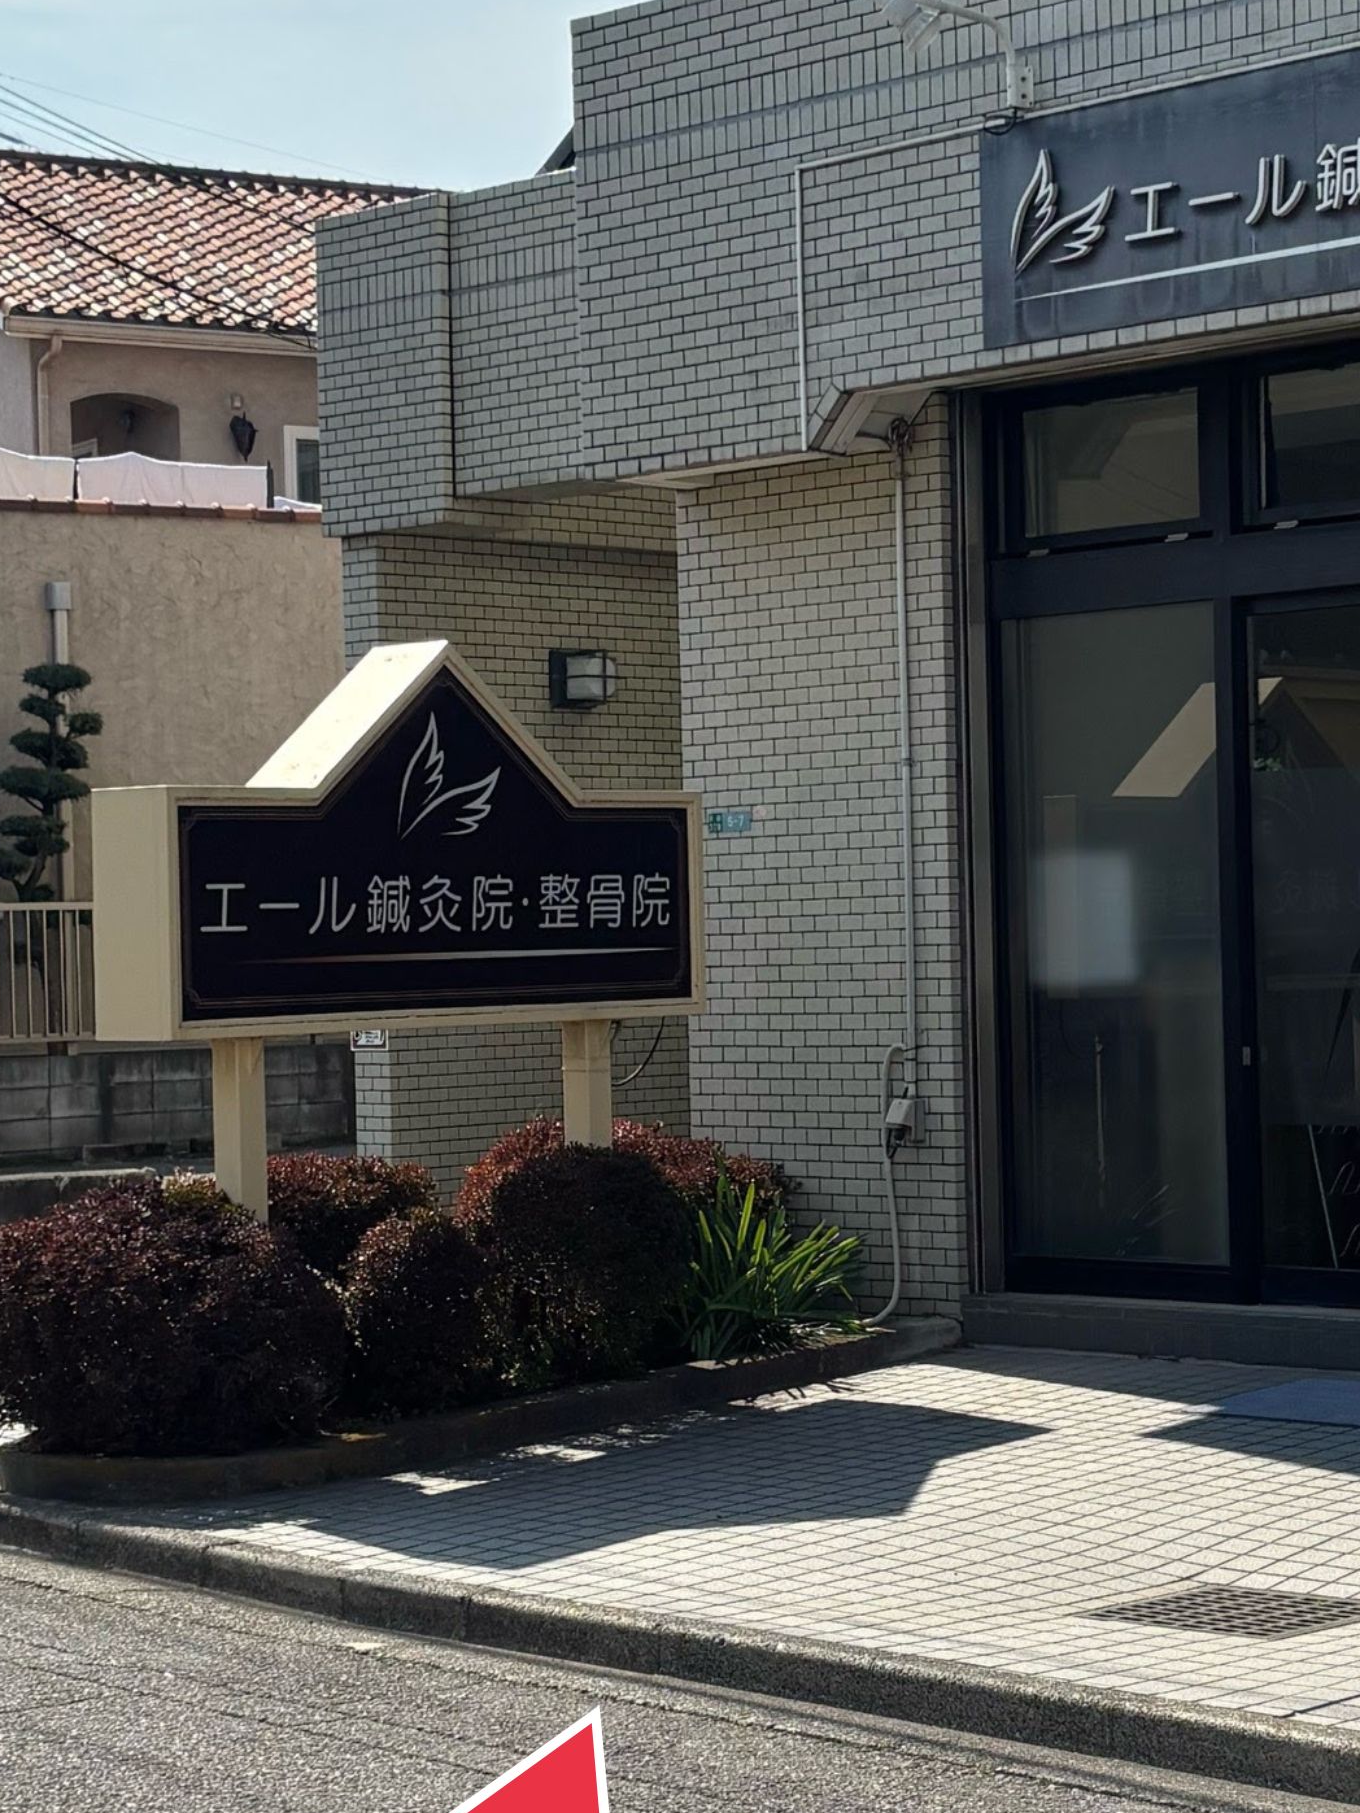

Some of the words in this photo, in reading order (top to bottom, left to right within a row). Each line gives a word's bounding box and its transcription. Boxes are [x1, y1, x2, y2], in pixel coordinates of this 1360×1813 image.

[199, 871, 672, 935] エール鍼灸院・整骨院
